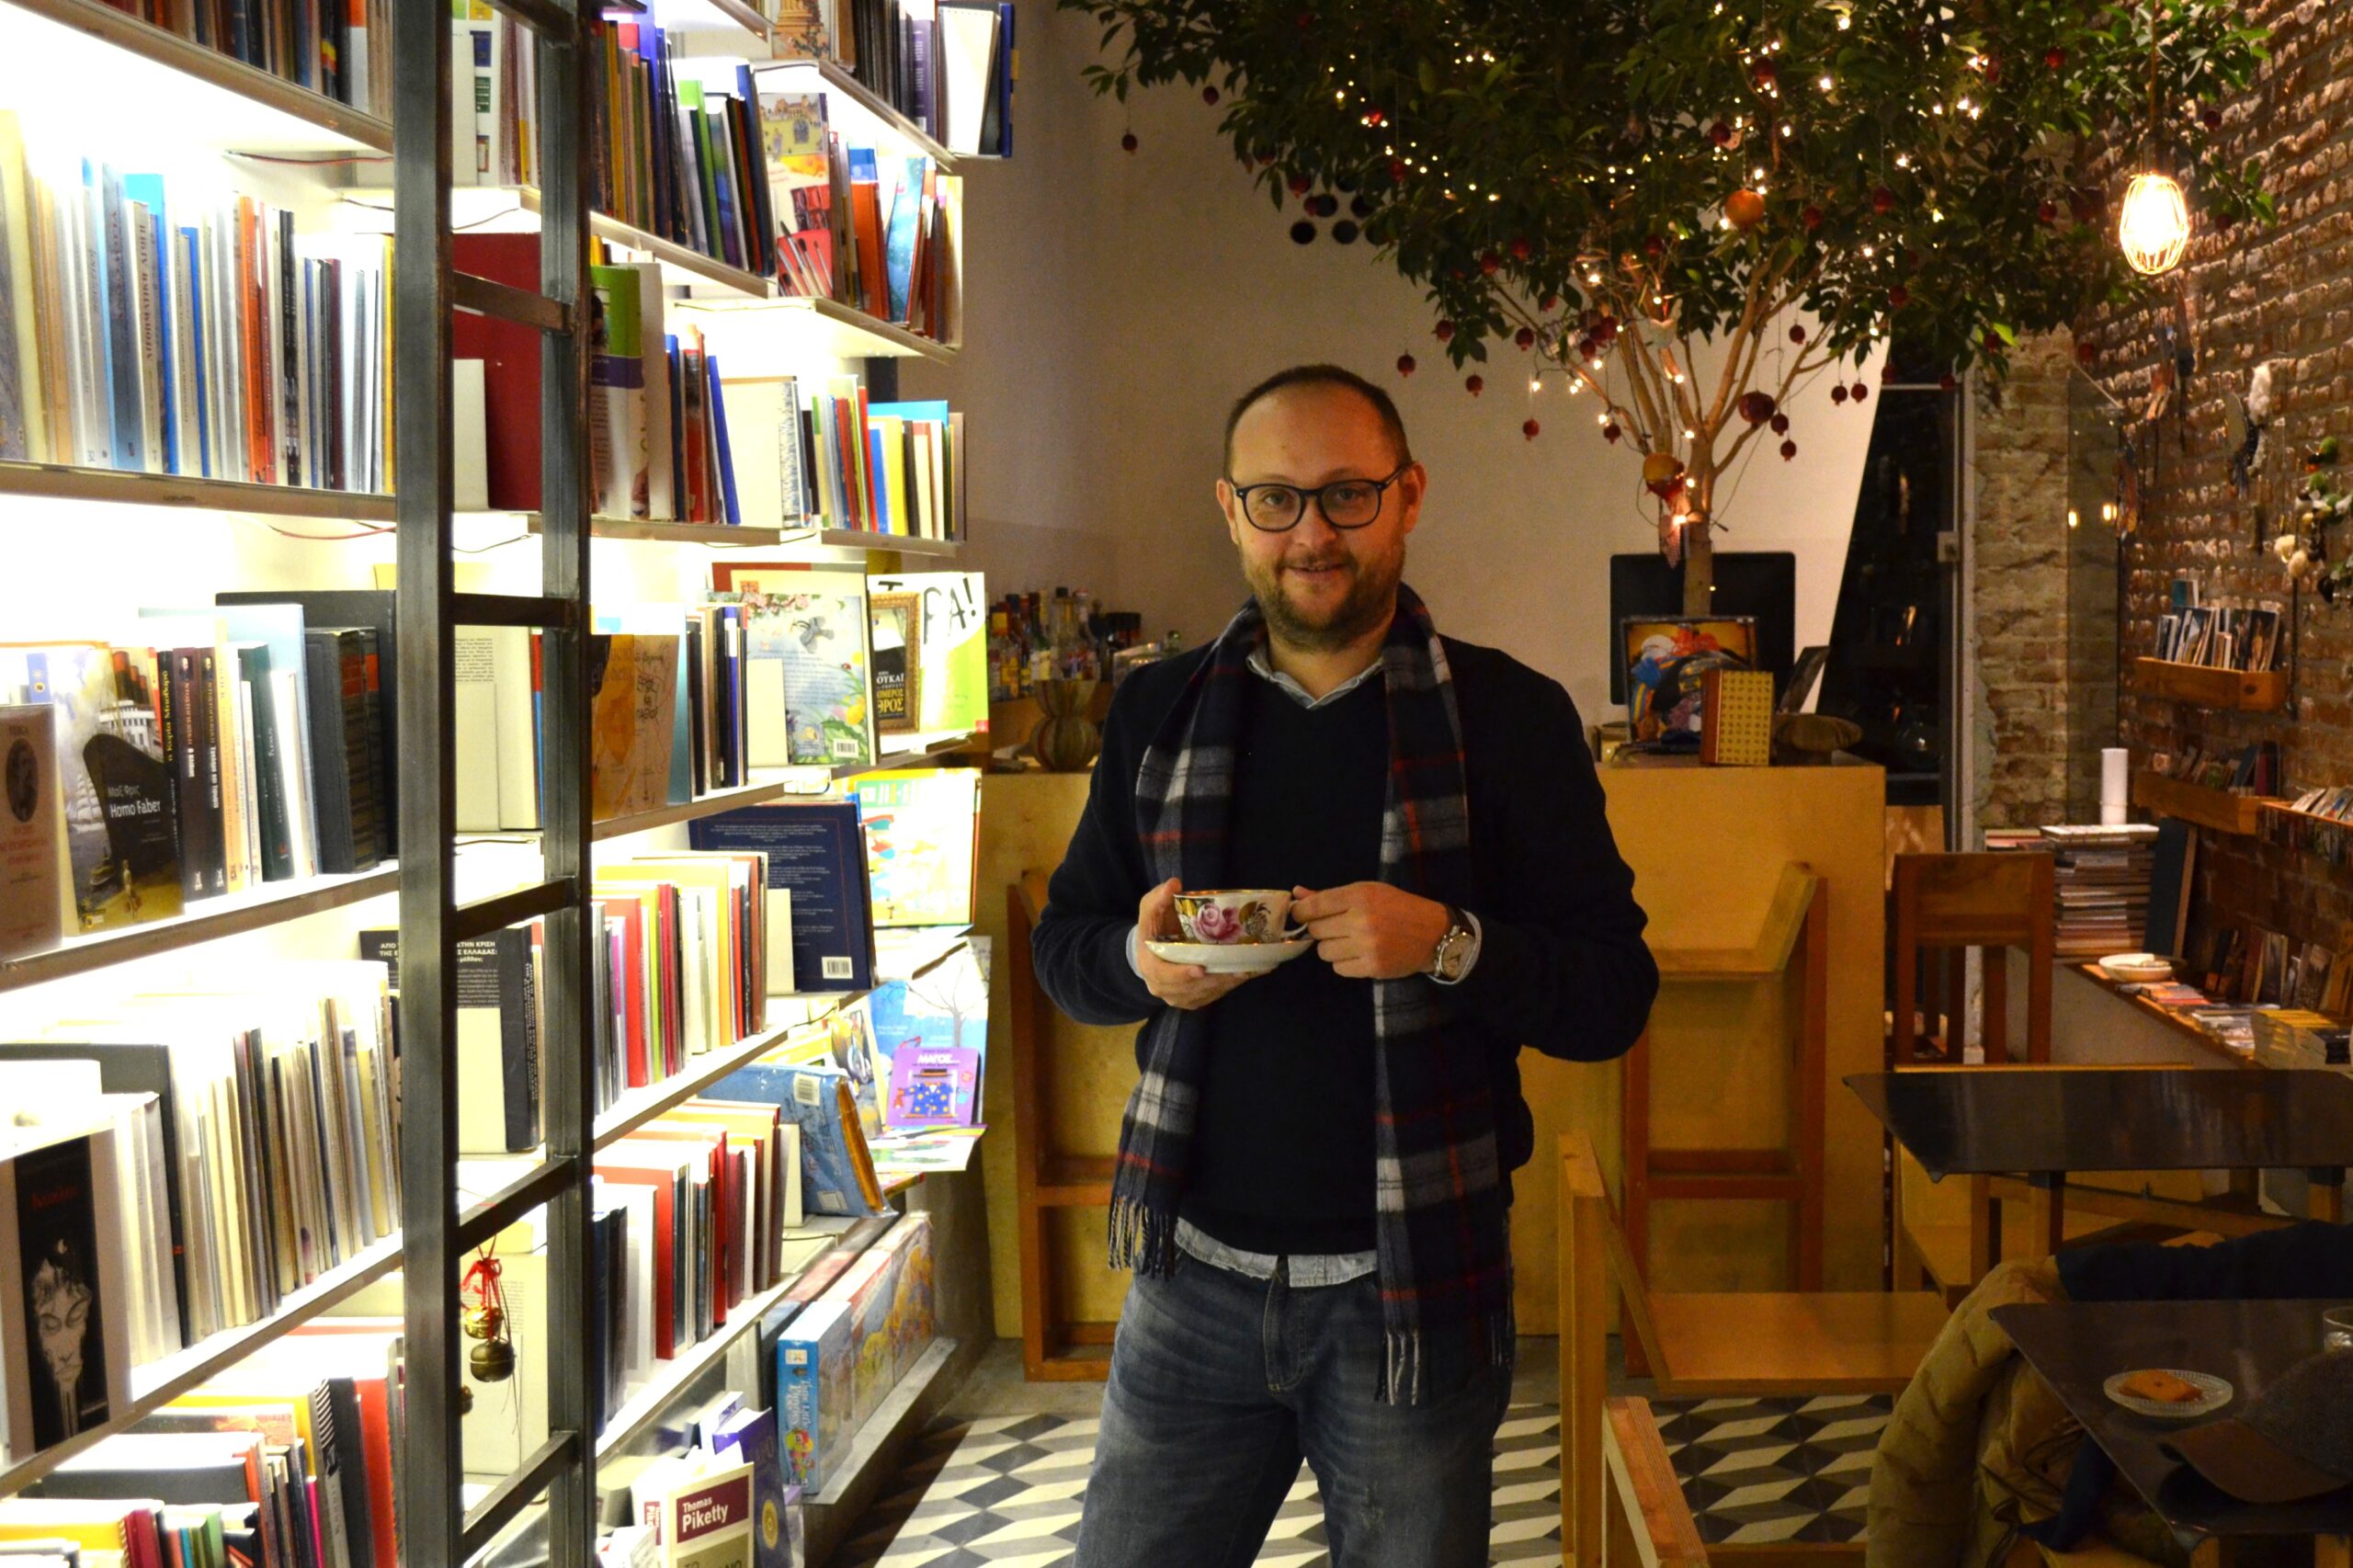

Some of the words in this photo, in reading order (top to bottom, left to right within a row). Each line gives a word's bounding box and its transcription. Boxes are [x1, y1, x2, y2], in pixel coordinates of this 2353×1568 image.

[109, 802, 135, 818] Homo
[136, 798, 161, 815] Faber
[683, 1496, 712, 1514] Thomas
[682, 1505, 729, 1533] Piketty
